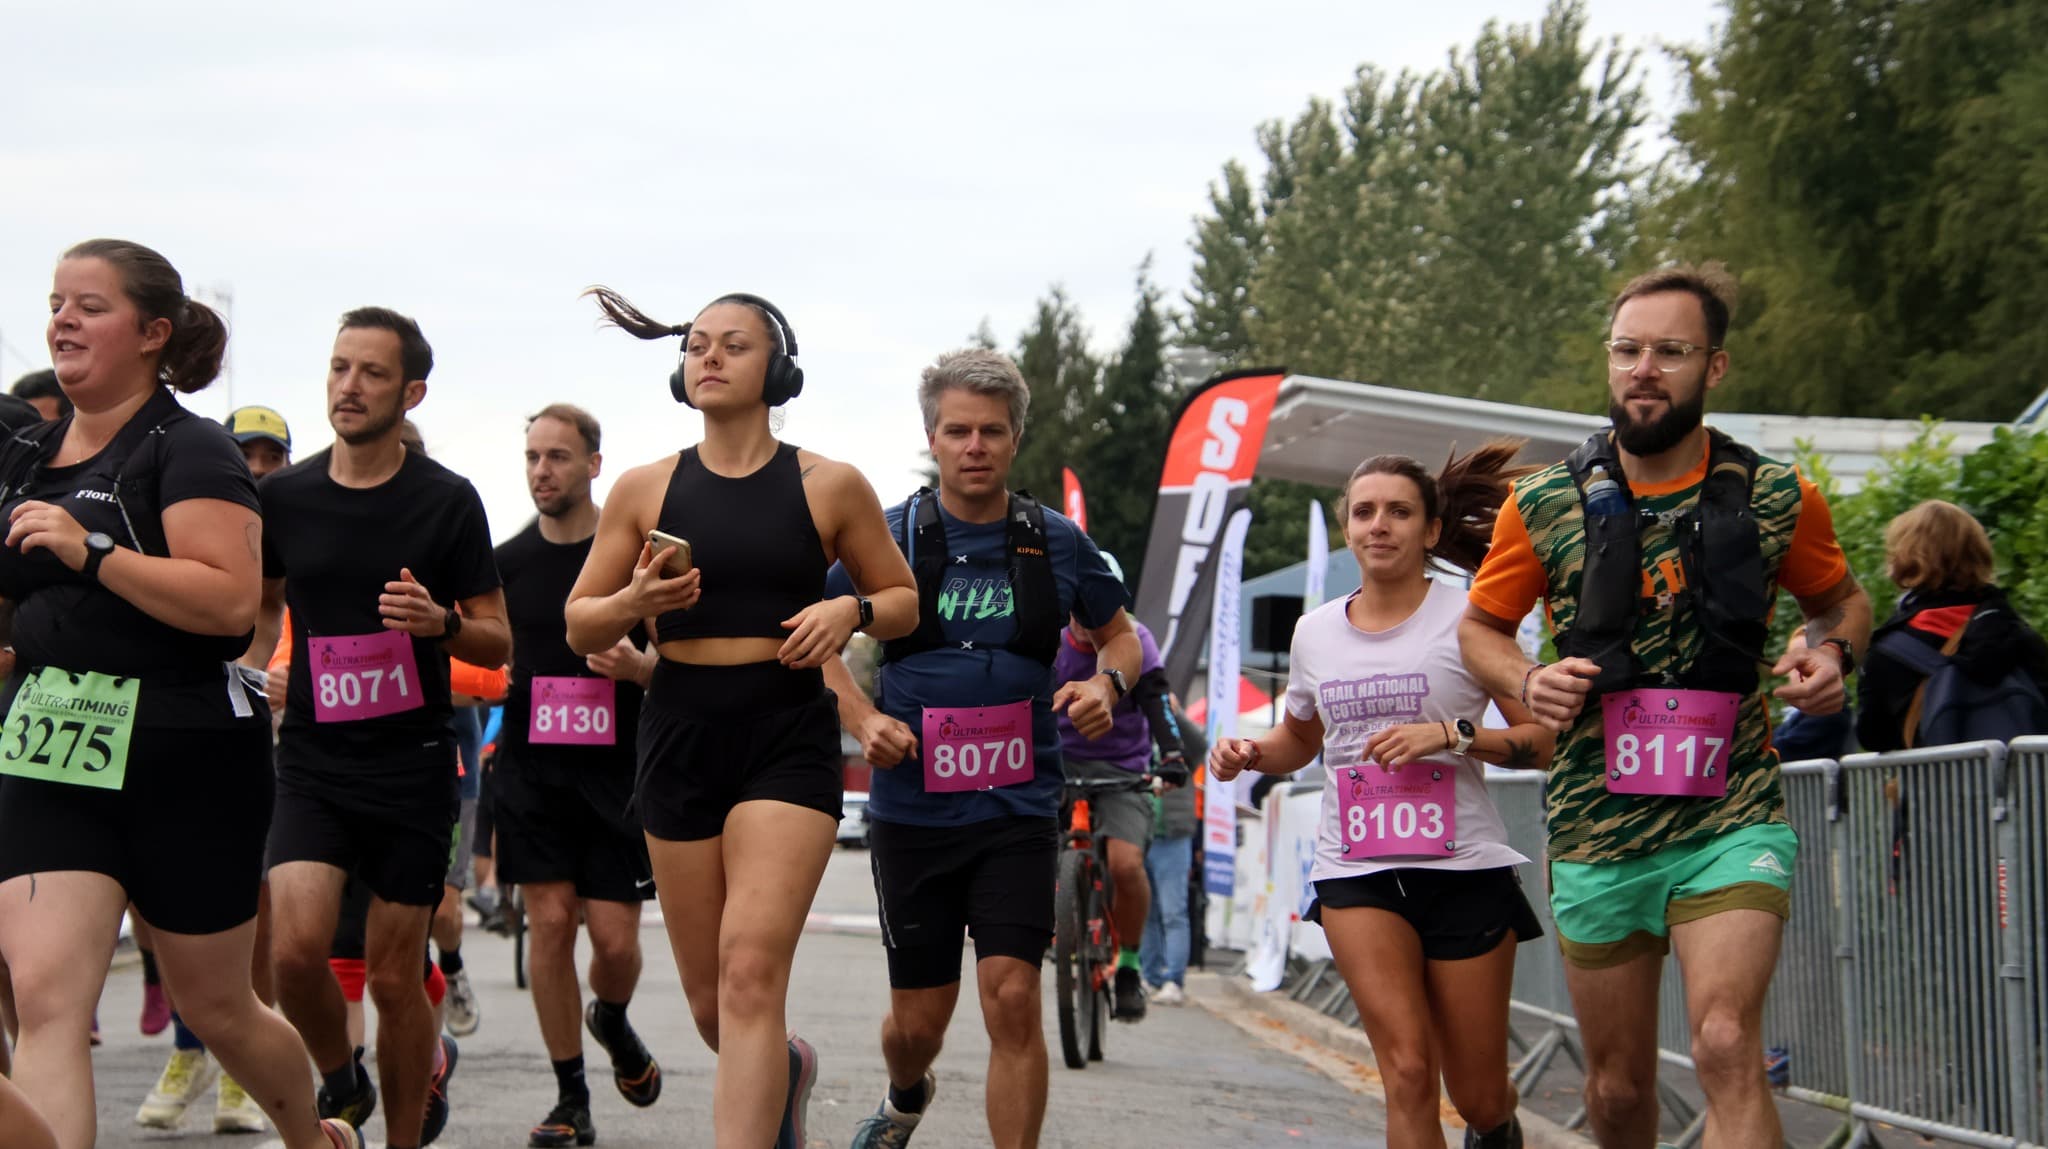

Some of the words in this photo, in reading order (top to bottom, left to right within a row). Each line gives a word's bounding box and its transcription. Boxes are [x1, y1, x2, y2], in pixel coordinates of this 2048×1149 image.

[30, 691, 129, 717] ULTRATIMING
[319, 663, 408, 708] 8071
[1322, 683, 1355, 704] TRAIL
[1358, 677, 1425, 698] NATIONAL
[536, 704, 609, 733] 8130
[5, 713, 116, 772] 3275
[934, 737, 1026, 778] 8070
[1616, 733, 1724, 777] 8117
[1348, 802, 1444, 842] 8103
